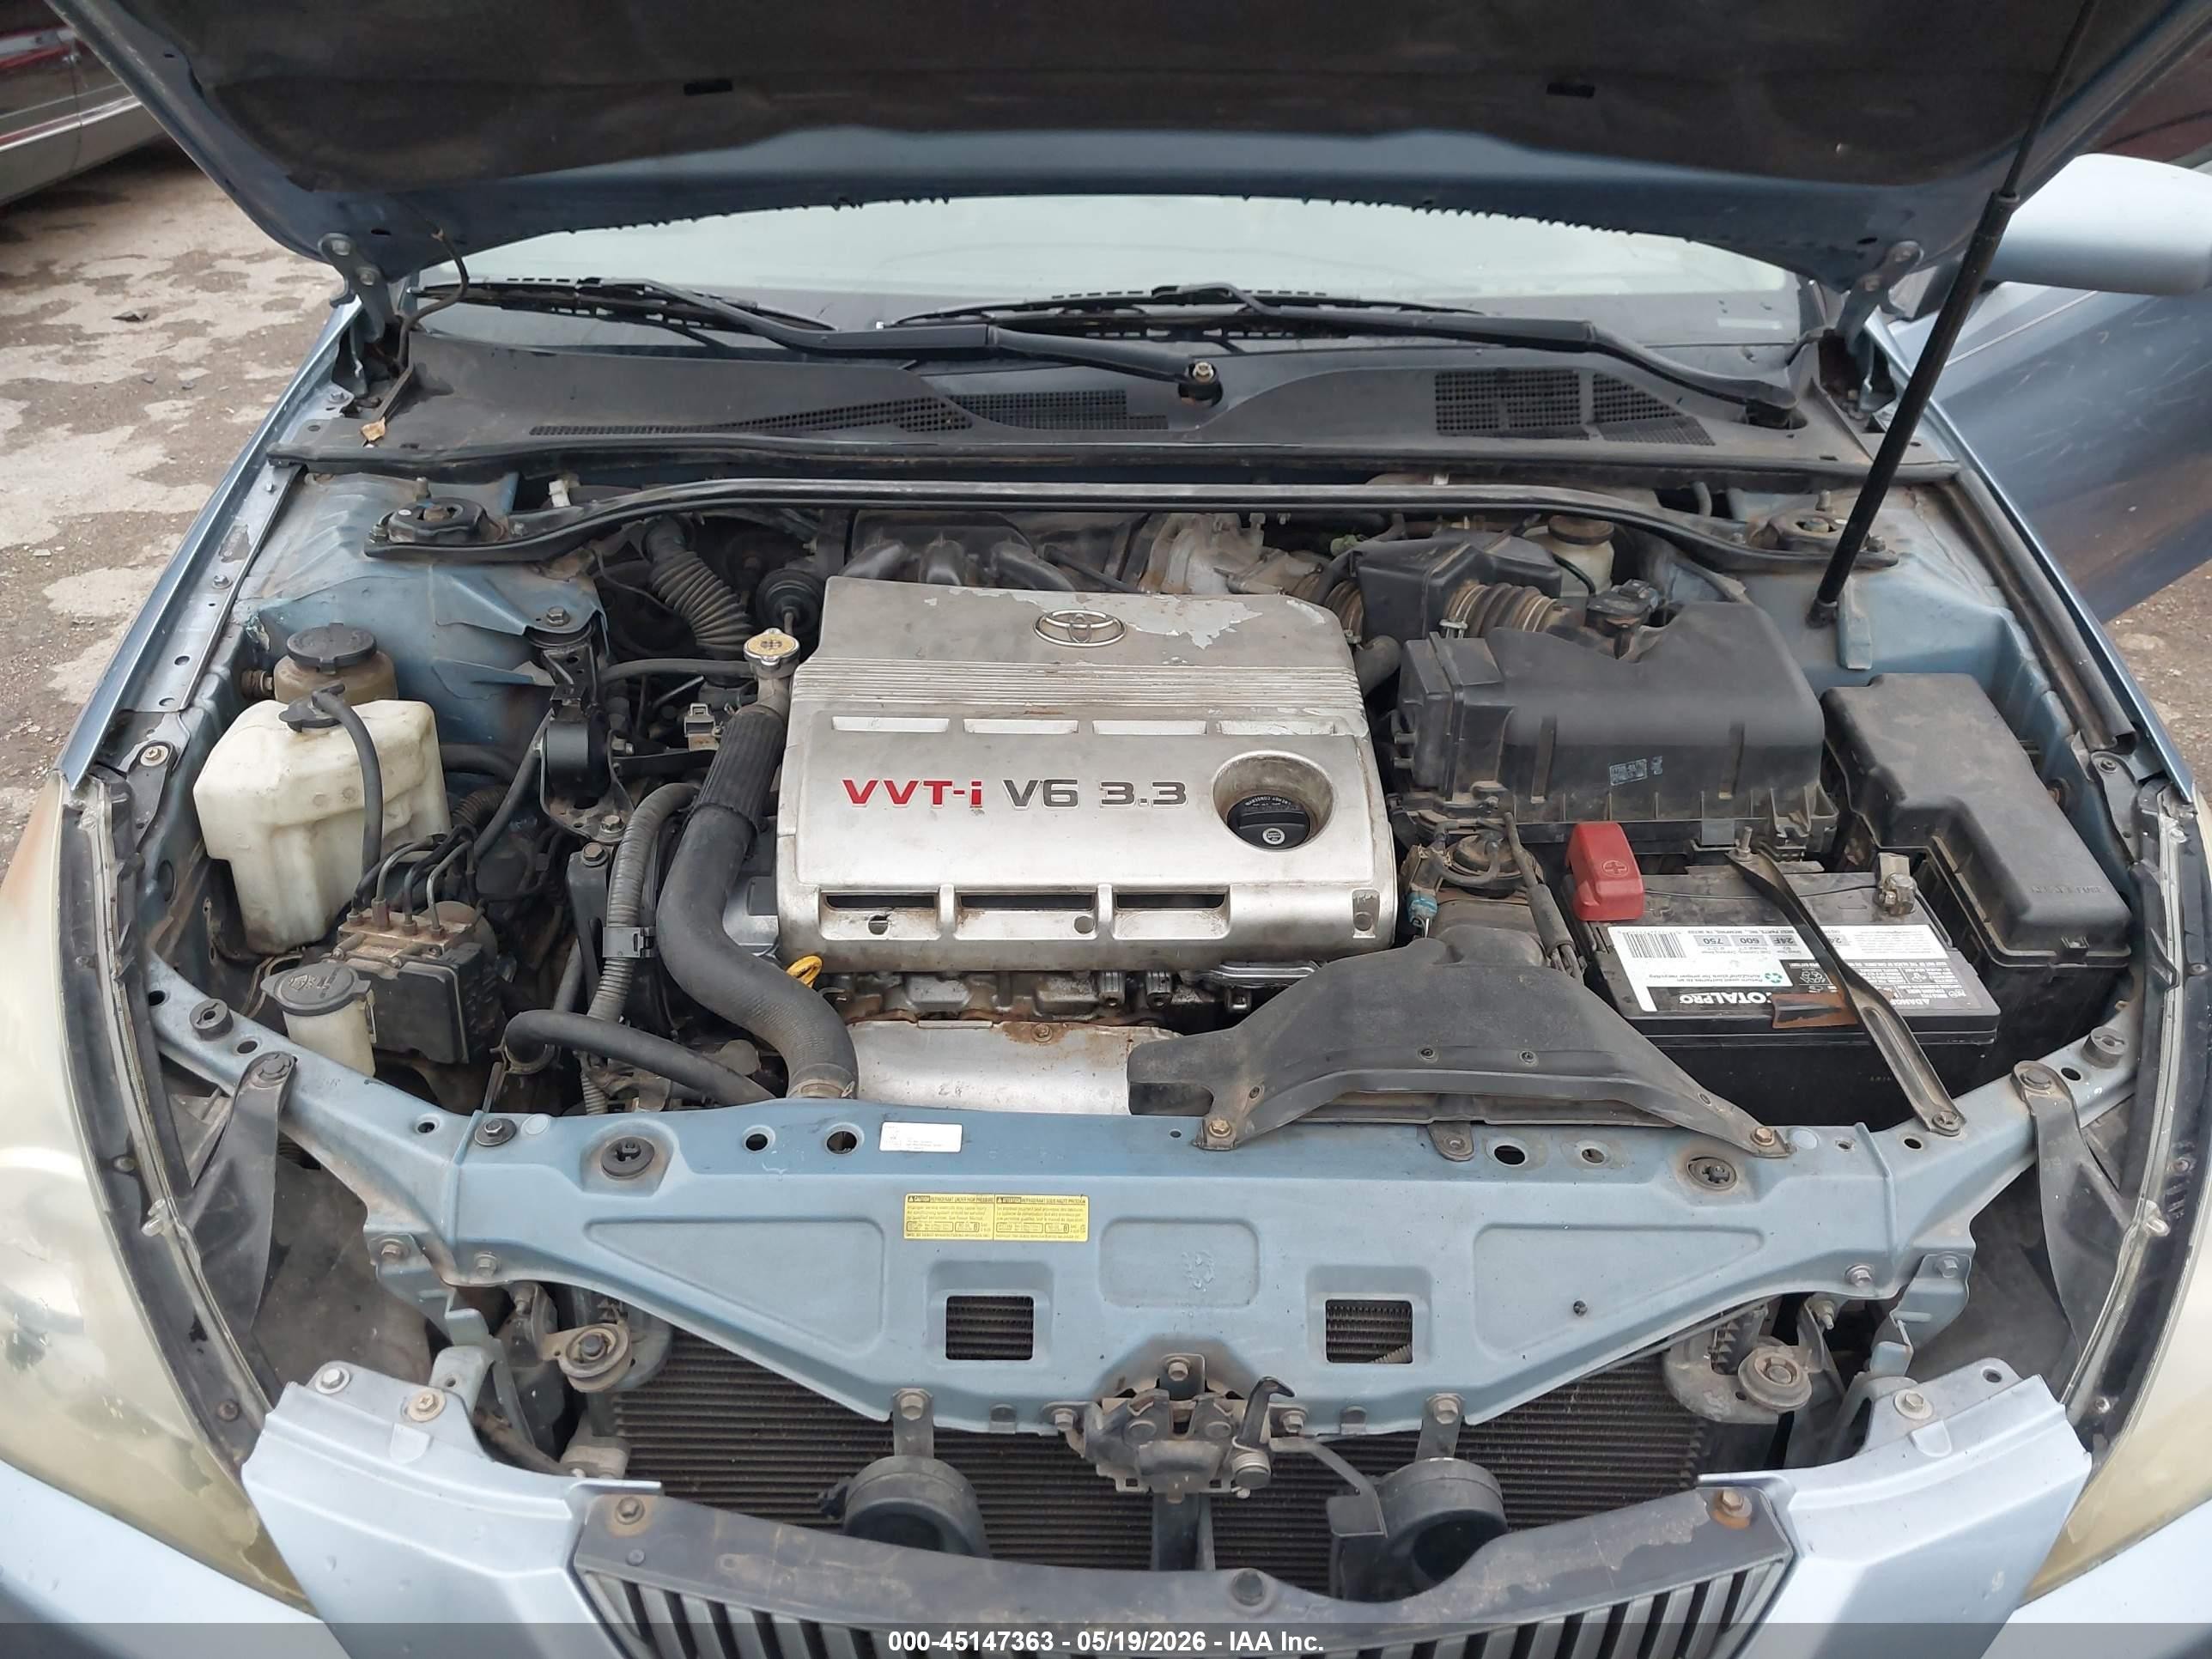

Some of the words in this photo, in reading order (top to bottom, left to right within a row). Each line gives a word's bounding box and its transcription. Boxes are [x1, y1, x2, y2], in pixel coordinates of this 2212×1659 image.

[842, 779, 983, 808] VVT-i
[1003, 779, 1079, 808] V6
[1100, 781, 1188, 806] 3.3
